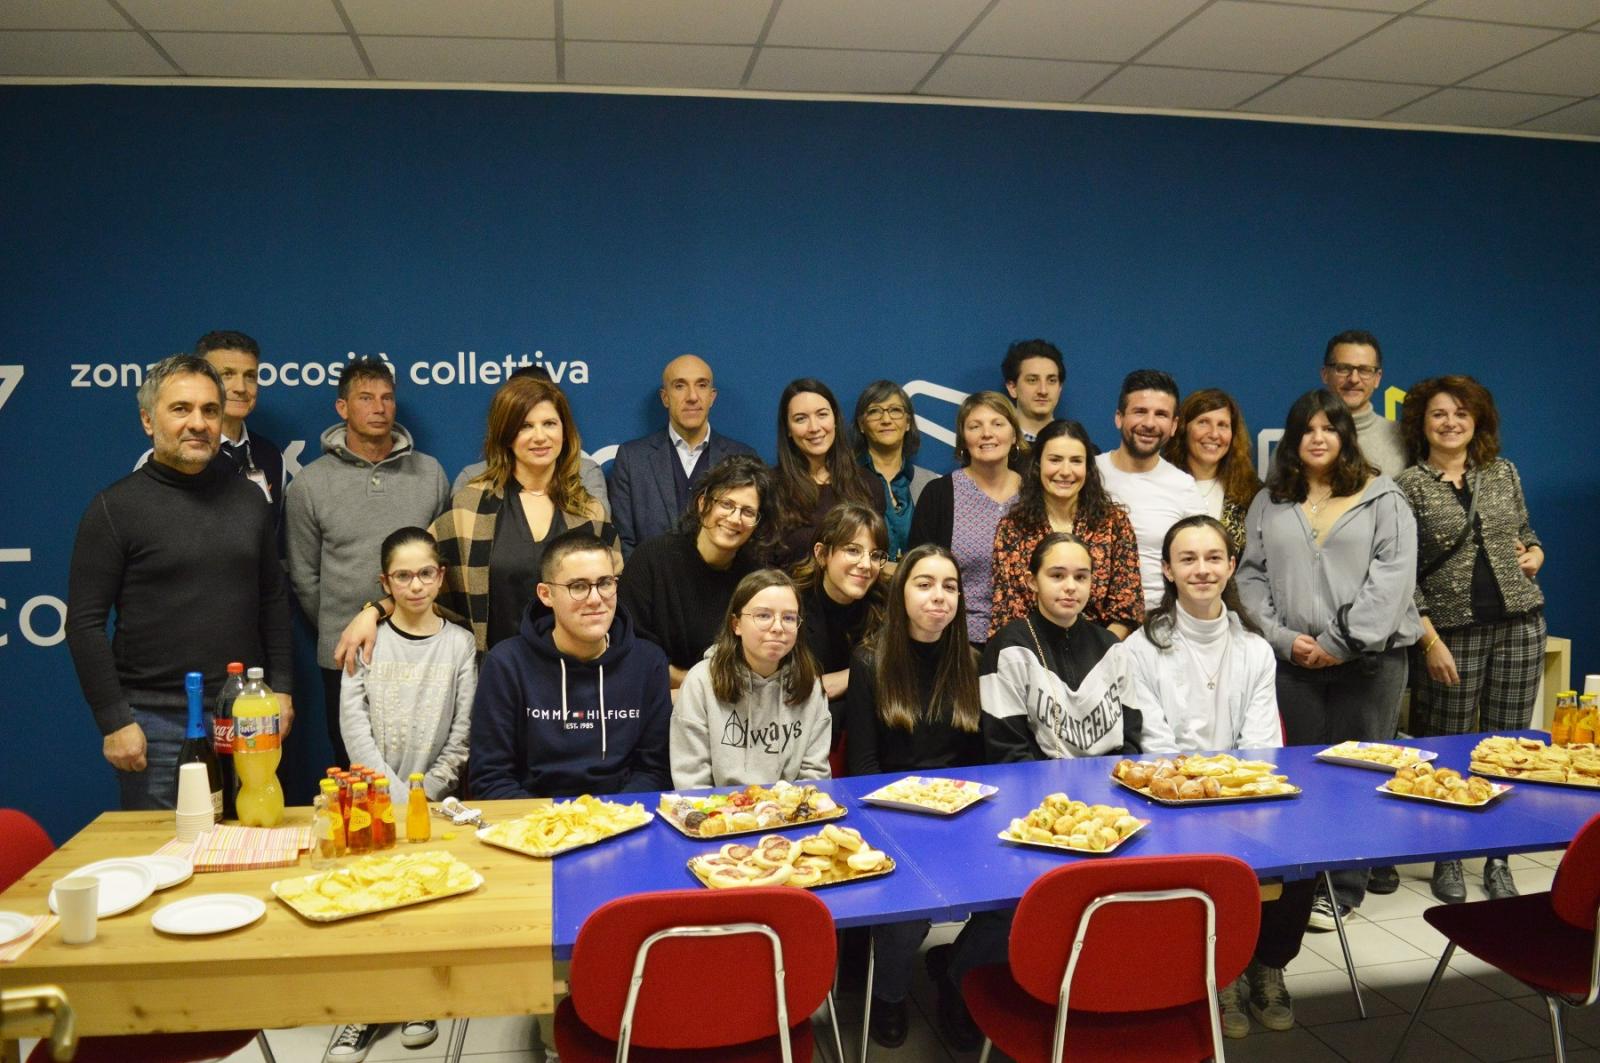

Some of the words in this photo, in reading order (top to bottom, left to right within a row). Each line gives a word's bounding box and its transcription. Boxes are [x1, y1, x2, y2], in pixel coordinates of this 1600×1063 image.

[71, 363, 156, 388] zon
[580, 722, 594, 730] 1985
[1059, 683, 1123, 751] ANGELES
